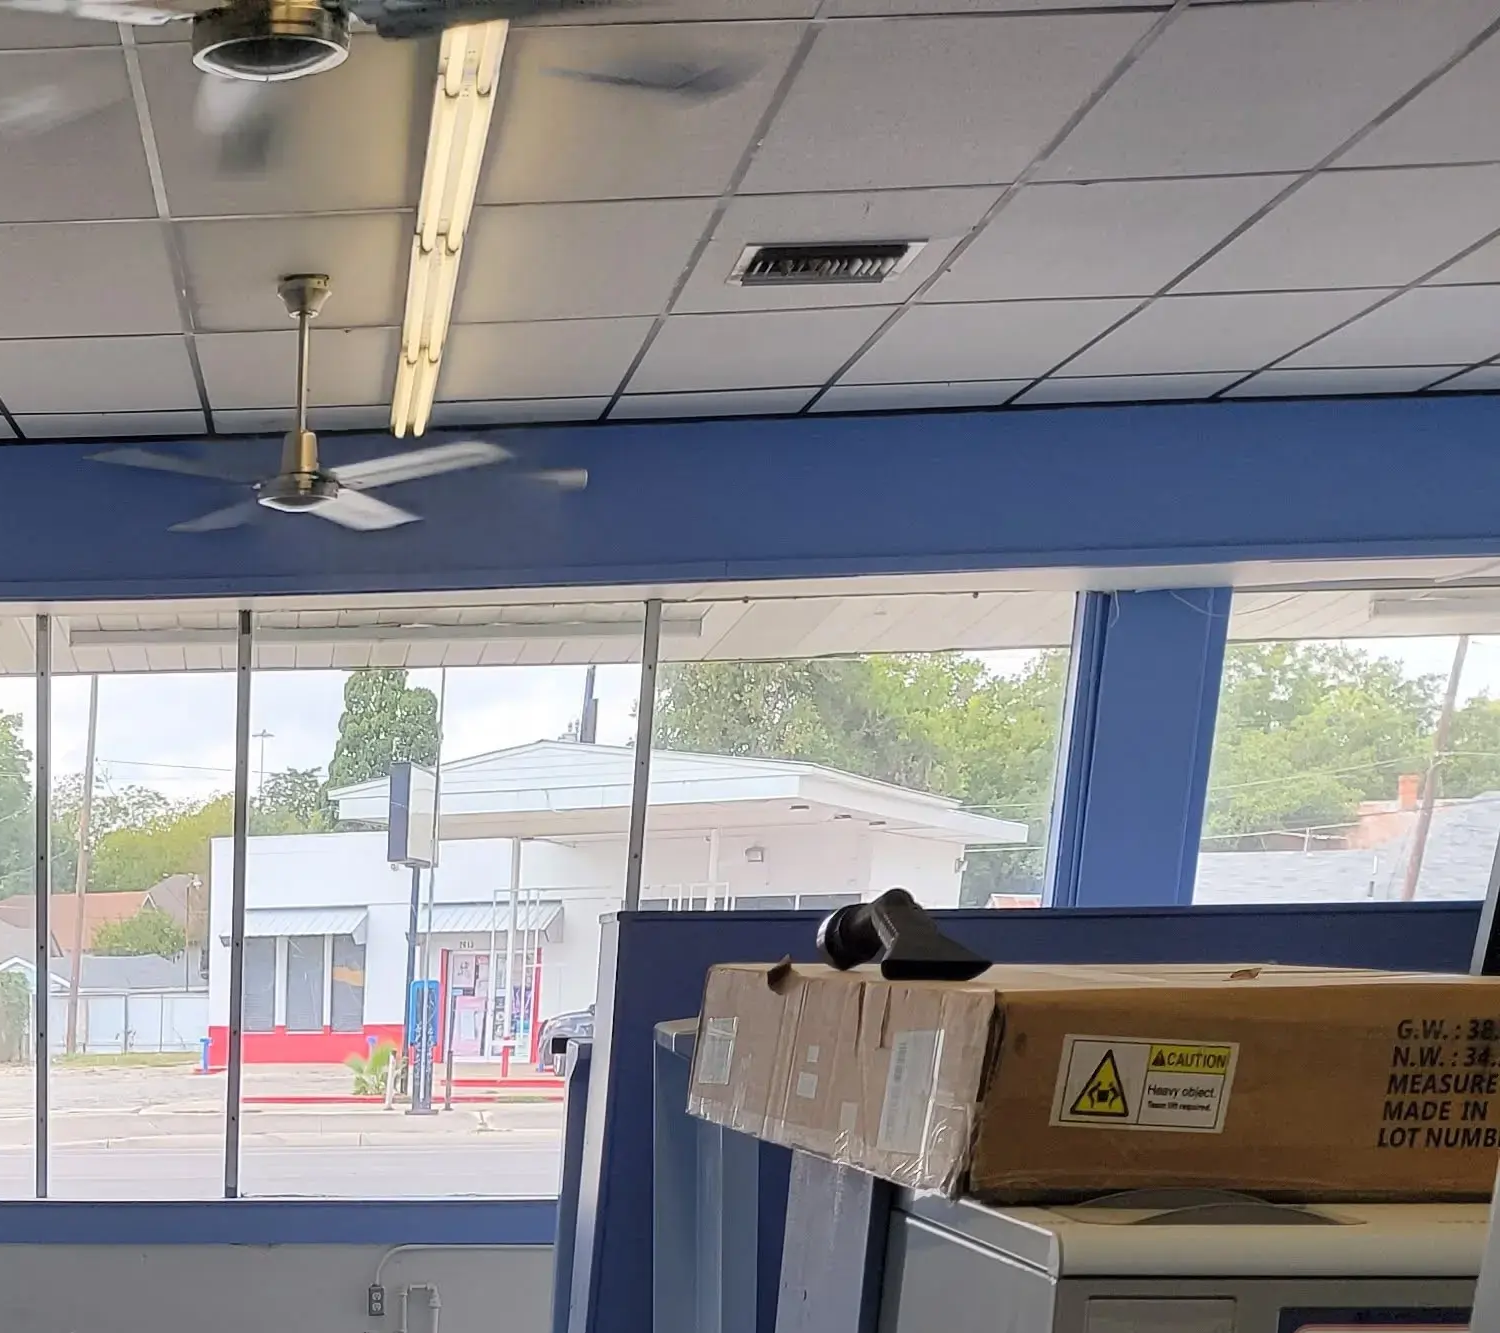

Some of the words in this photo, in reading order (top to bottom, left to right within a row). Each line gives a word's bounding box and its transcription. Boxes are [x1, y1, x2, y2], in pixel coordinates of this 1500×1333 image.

[1167, 1051, 1227, 1069] CAUTION
[1147, 1084, 1180, 1099] Heavy
[1386, 1073, 1499, 1095] MEASURE
[1382, 1101, 1451, 1121] MADE
[1461, 1101, 1489, 1121] IN
[1377, 1127, 1420, 1148] LOT
[1425, 1127, 1500, 1148] NUMB
